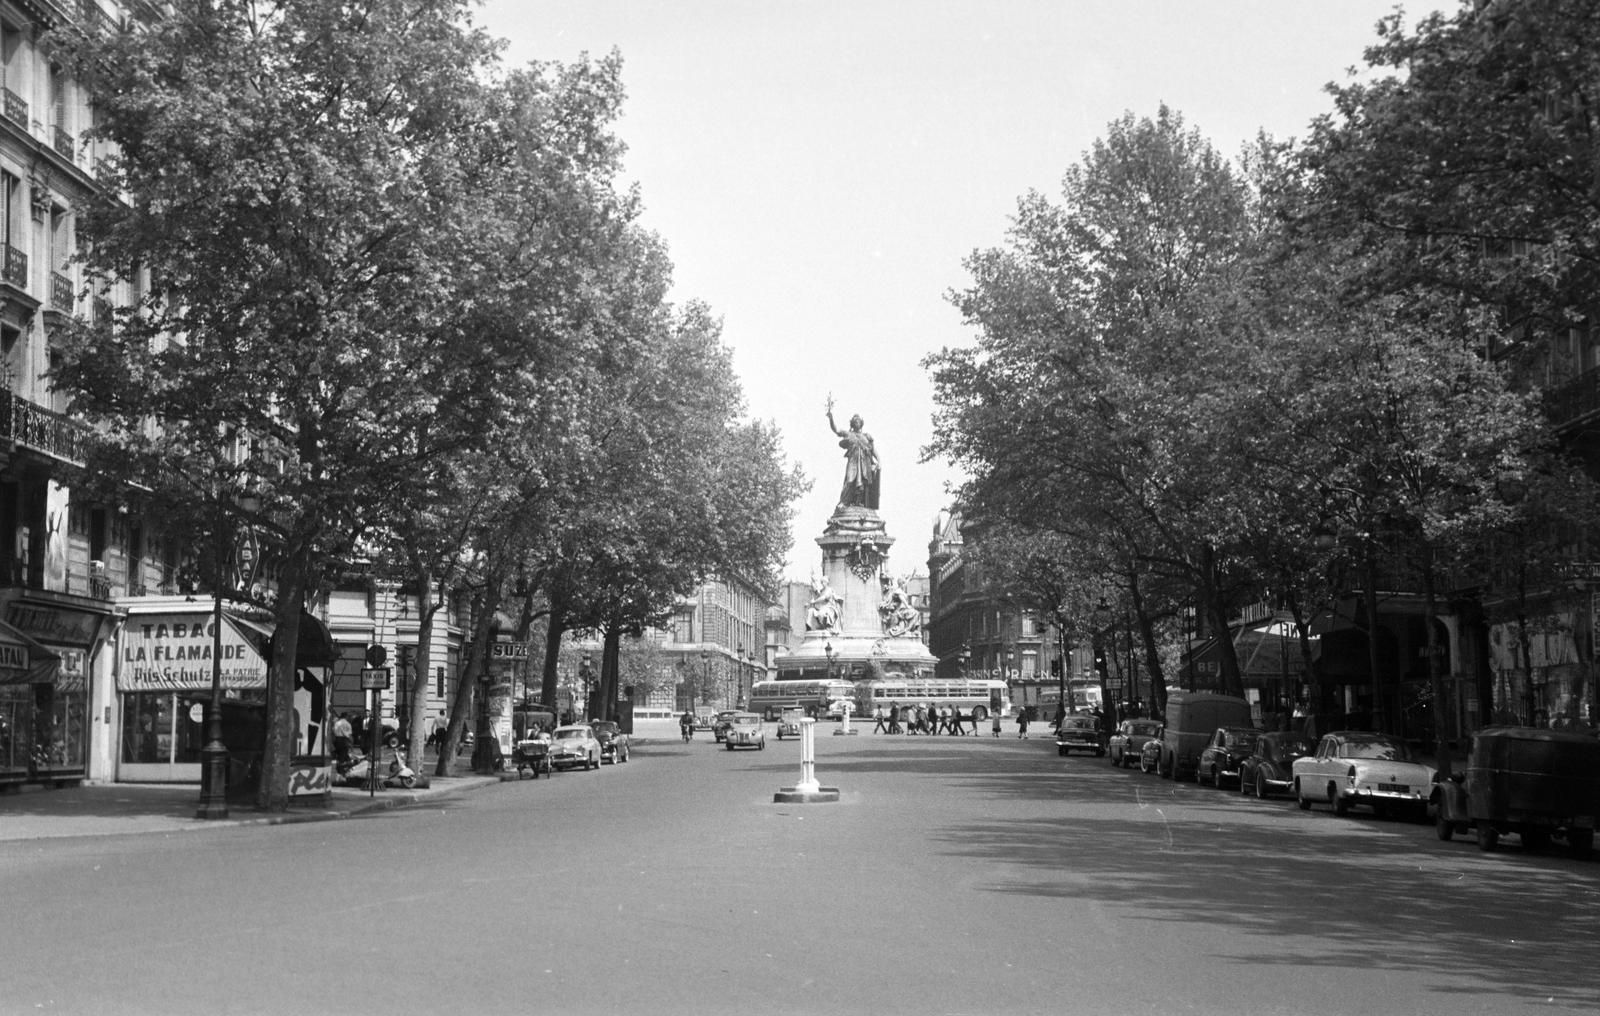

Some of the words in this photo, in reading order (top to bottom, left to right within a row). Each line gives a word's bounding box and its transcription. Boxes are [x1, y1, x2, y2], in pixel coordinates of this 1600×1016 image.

[242, 530, 253, 579] ABAC
[125, 647, 147, 662] LA
[154, 645, 246, 661] FLAMADE
